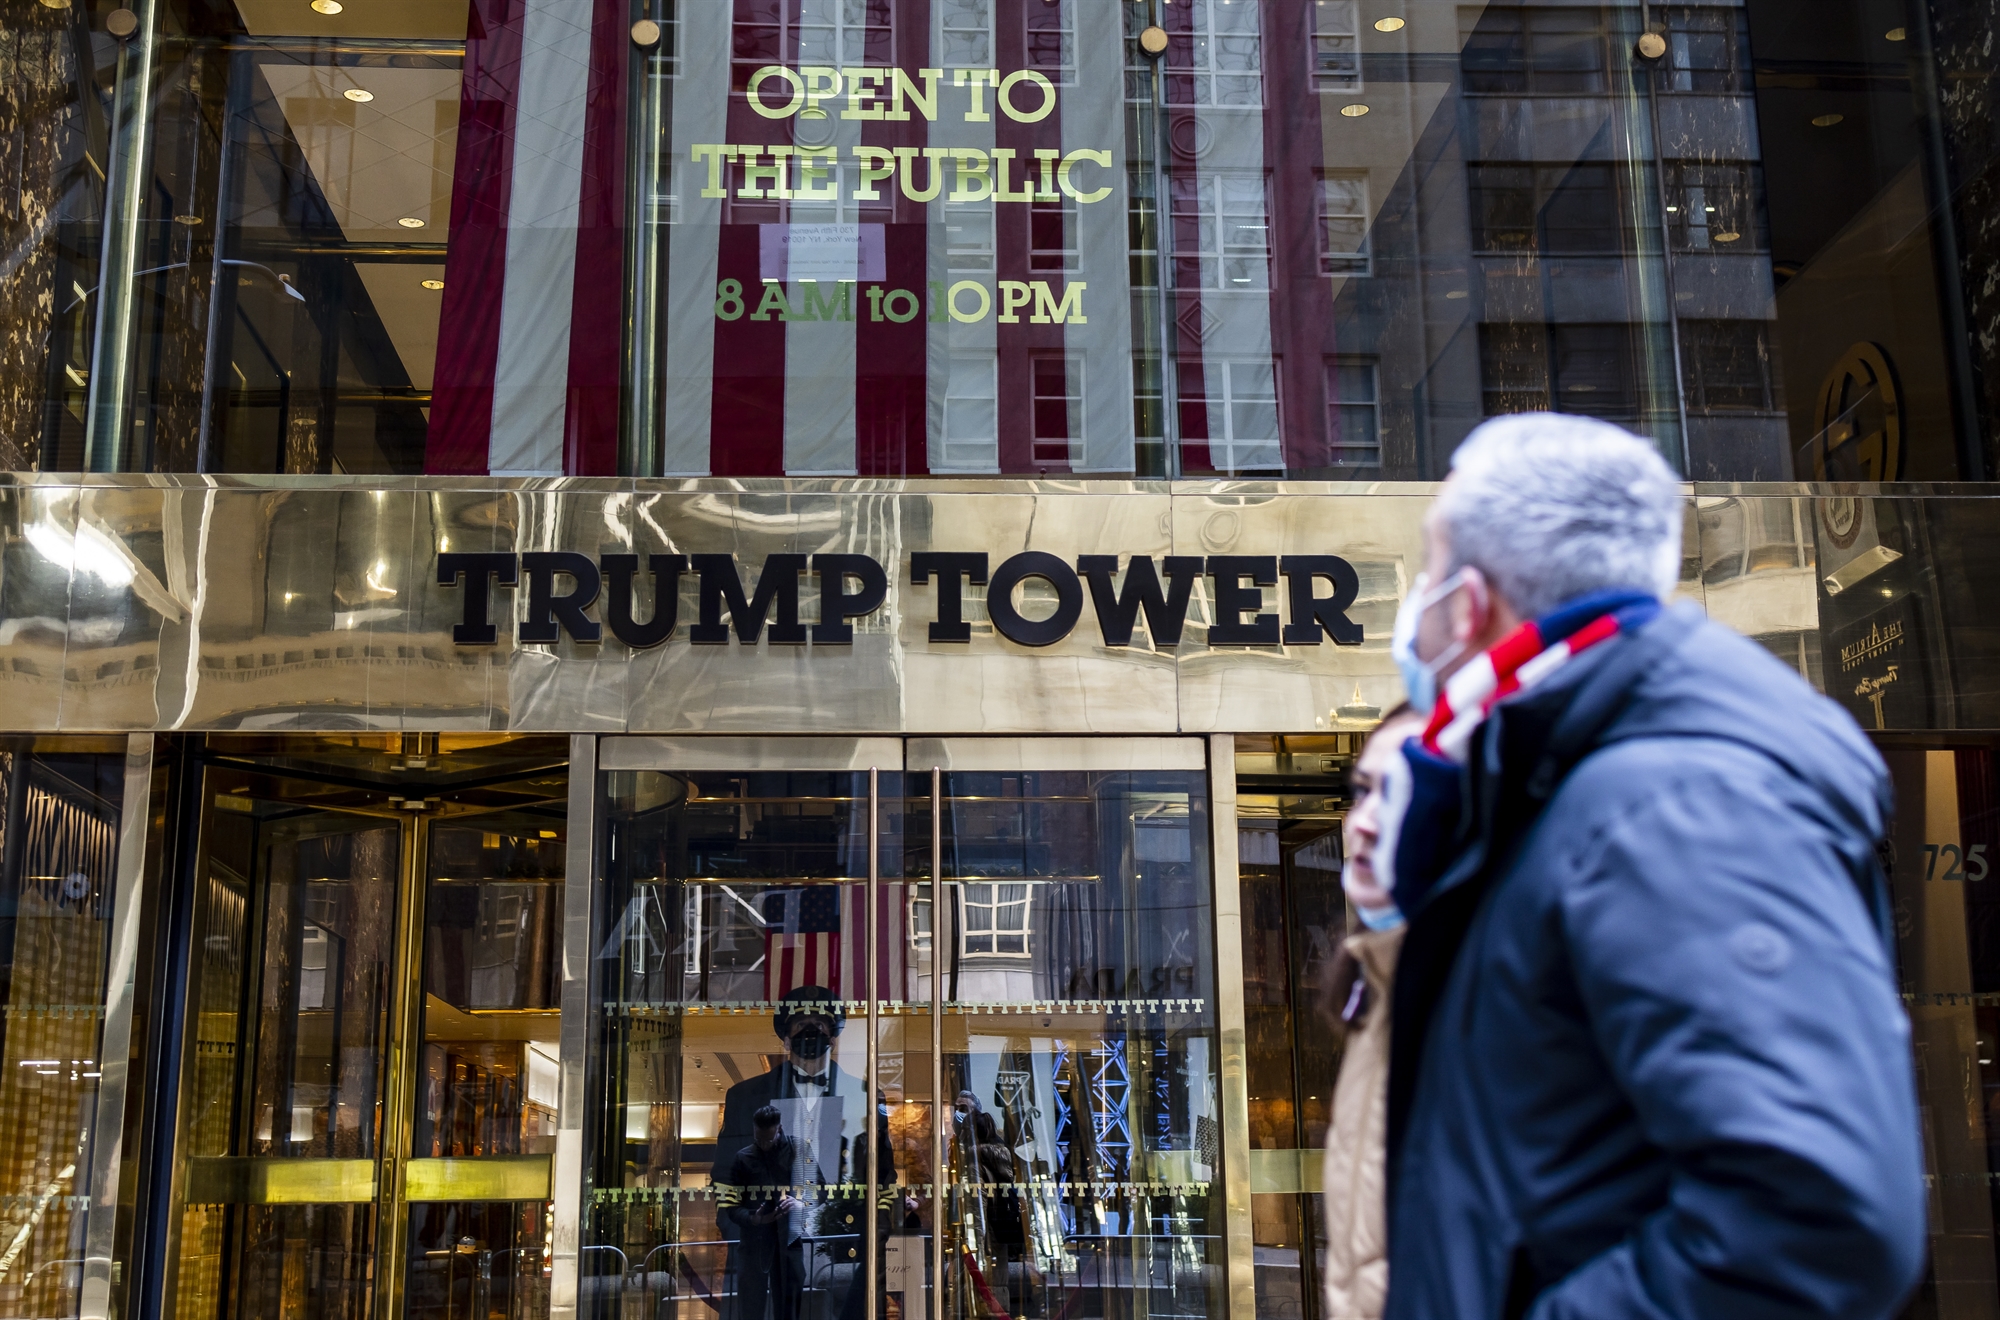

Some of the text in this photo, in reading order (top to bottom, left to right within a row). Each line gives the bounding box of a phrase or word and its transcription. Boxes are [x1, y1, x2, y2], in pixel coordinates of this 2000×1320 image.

[746, 65, 1057, 123] OPEN TO
[691, 143, 1114, 204] THE PUBLIC
[714, 277, 1088, 324] 8 AM to 10 PM
[437, 551, 1366, 649] TRUMP TOWER
[1921, 844, 1989, 882] 725
